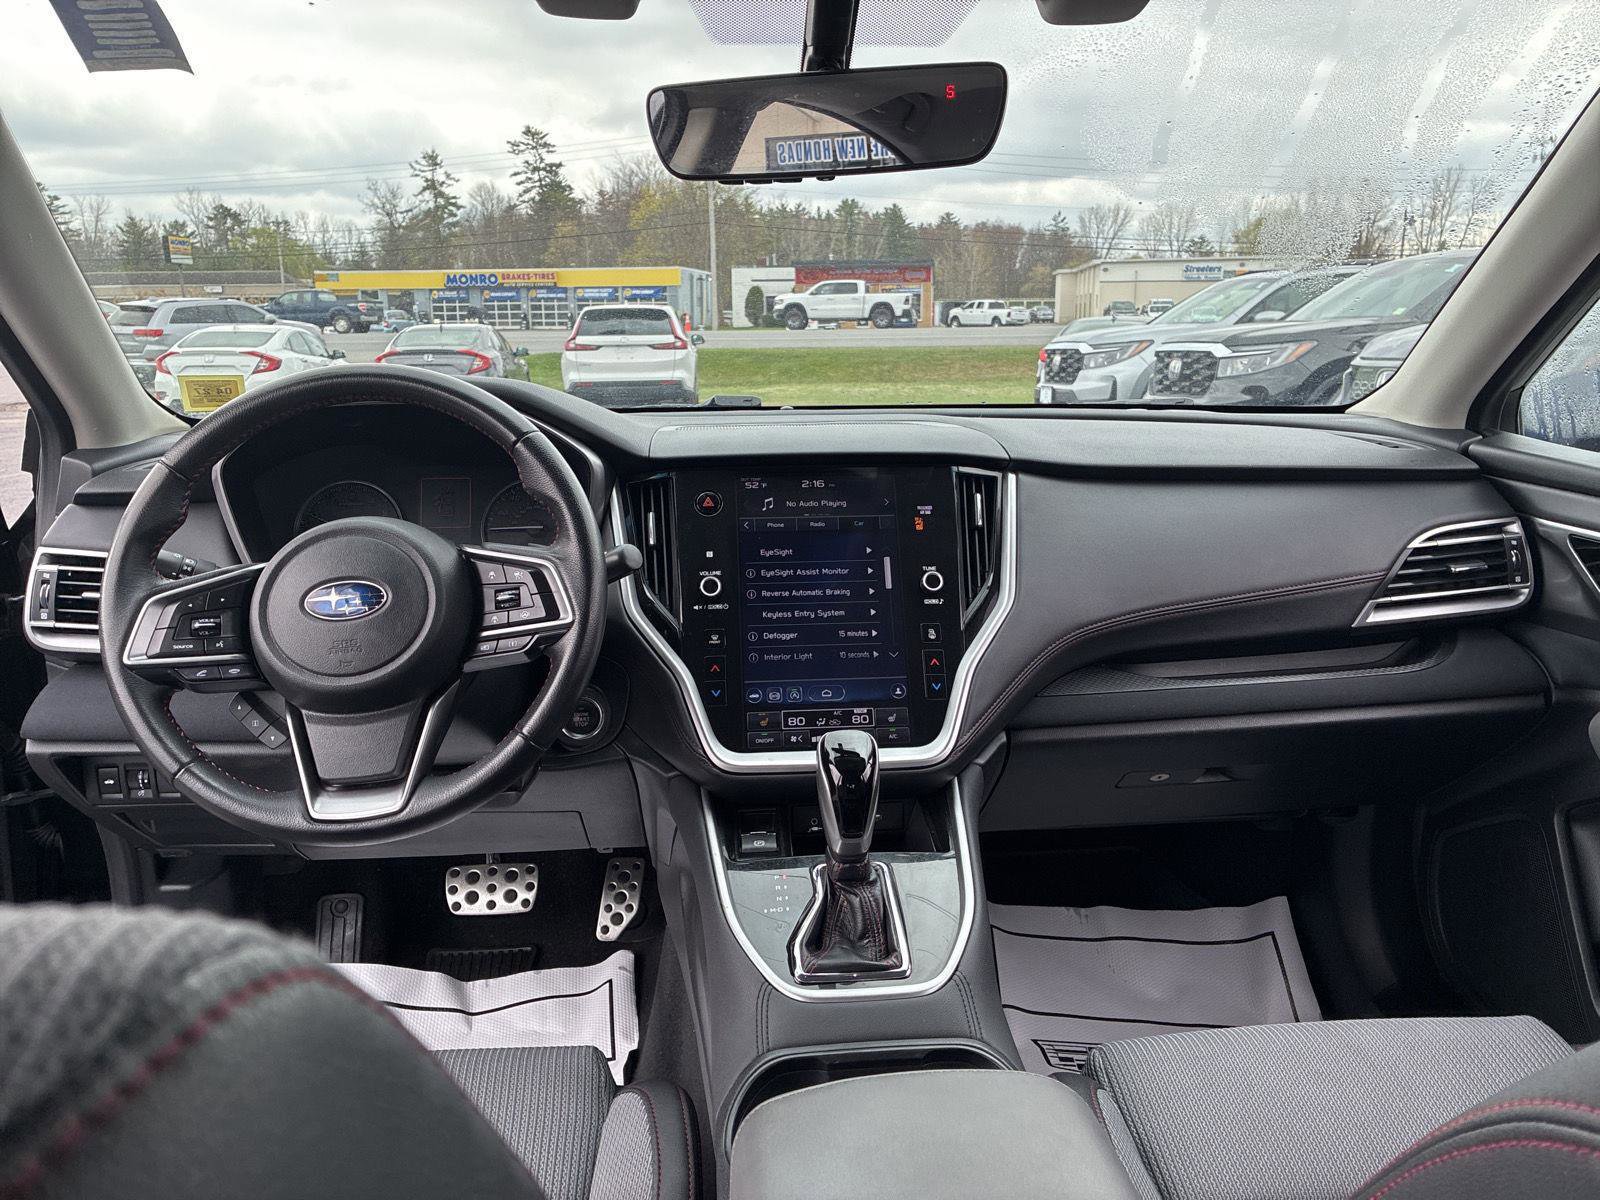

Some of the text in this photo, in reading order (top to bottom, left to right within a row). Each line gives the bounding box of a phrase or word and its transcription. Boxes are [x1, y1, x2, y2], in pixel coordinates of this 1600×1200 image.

[1184, 264, 1222, 273] Streeters
[446, 273, 499, 286] MONRO
[801, 480, 825, 488] 2:16
[821, 500, 847, 508] Playing
[817, 610, 845, 618] System
[764, 632, 798, 640] Defogger
[794, 653, 812, 661] Light
[788, 716, 869, 726] 80 80
